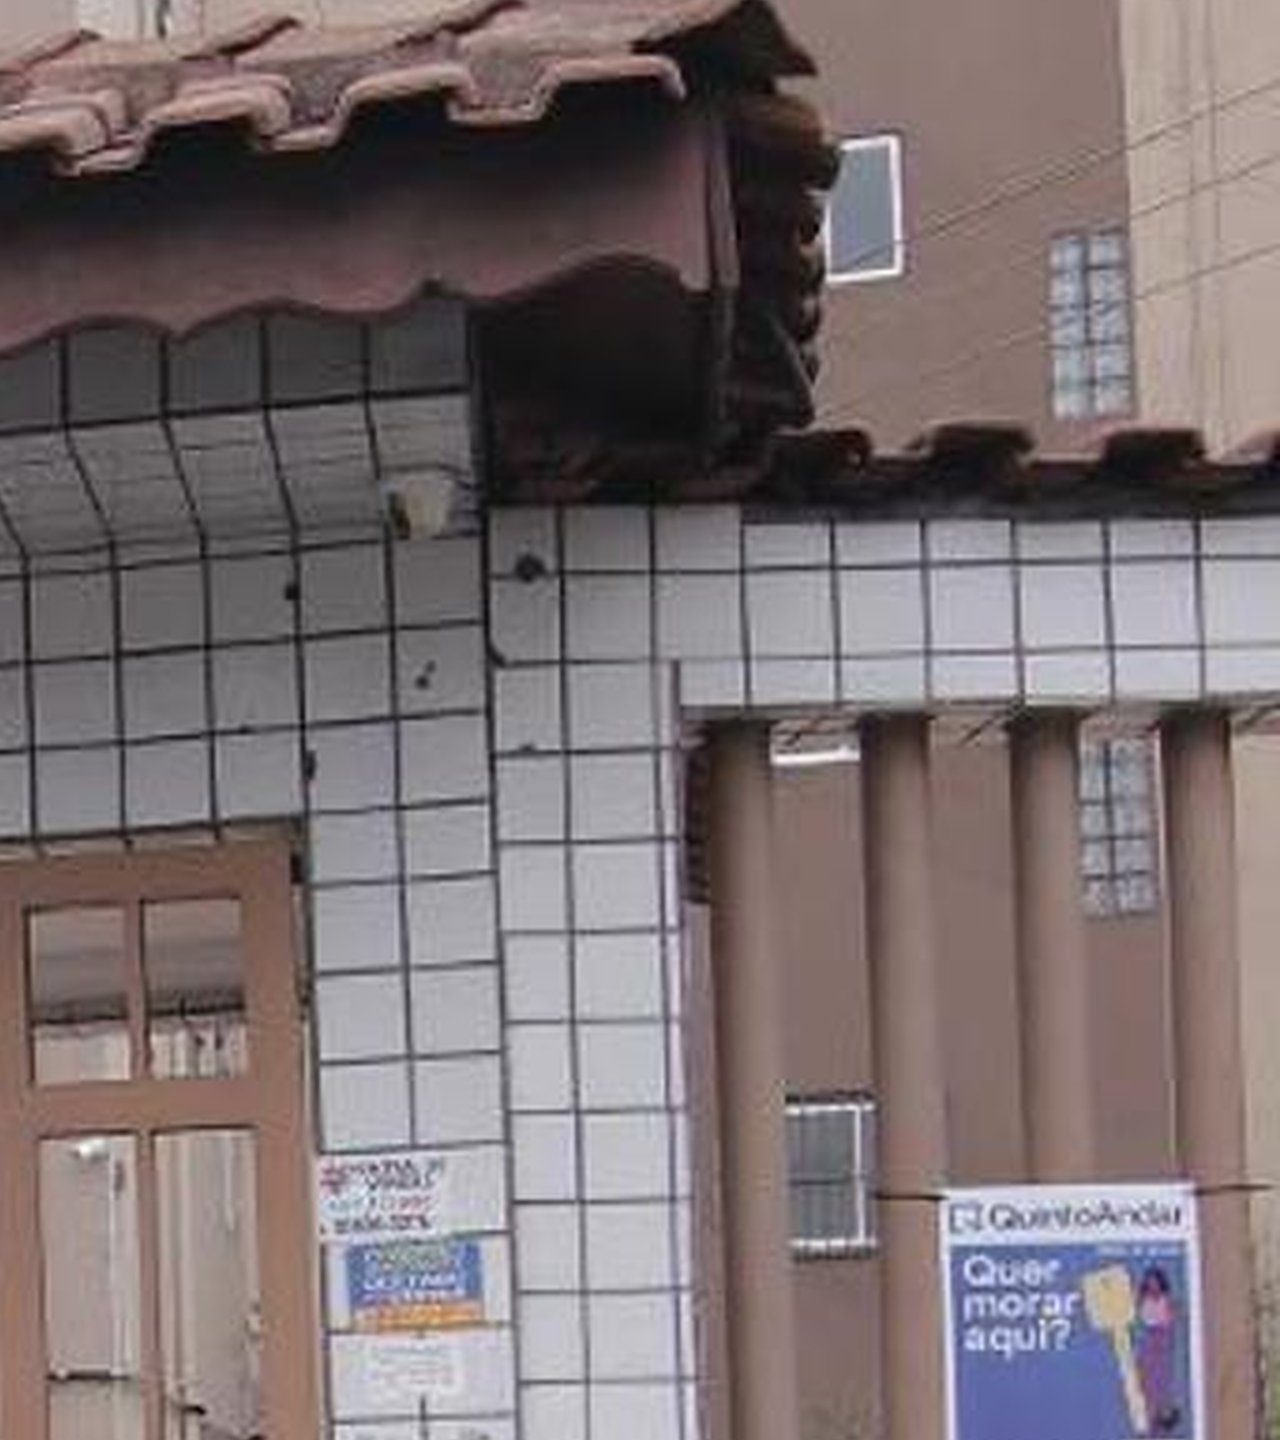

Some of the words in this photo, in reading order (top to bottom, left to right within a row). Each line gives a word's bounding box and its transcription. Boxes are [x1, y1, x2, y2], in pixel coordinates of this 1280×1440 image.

[989, 1201, 1182, 1231] QuintoAndar
[963, 1254, 1060, 1287] Quer
[963, 1292, 1081, 1321] morar
[963, 1318, 1071, 1360] aqui?
